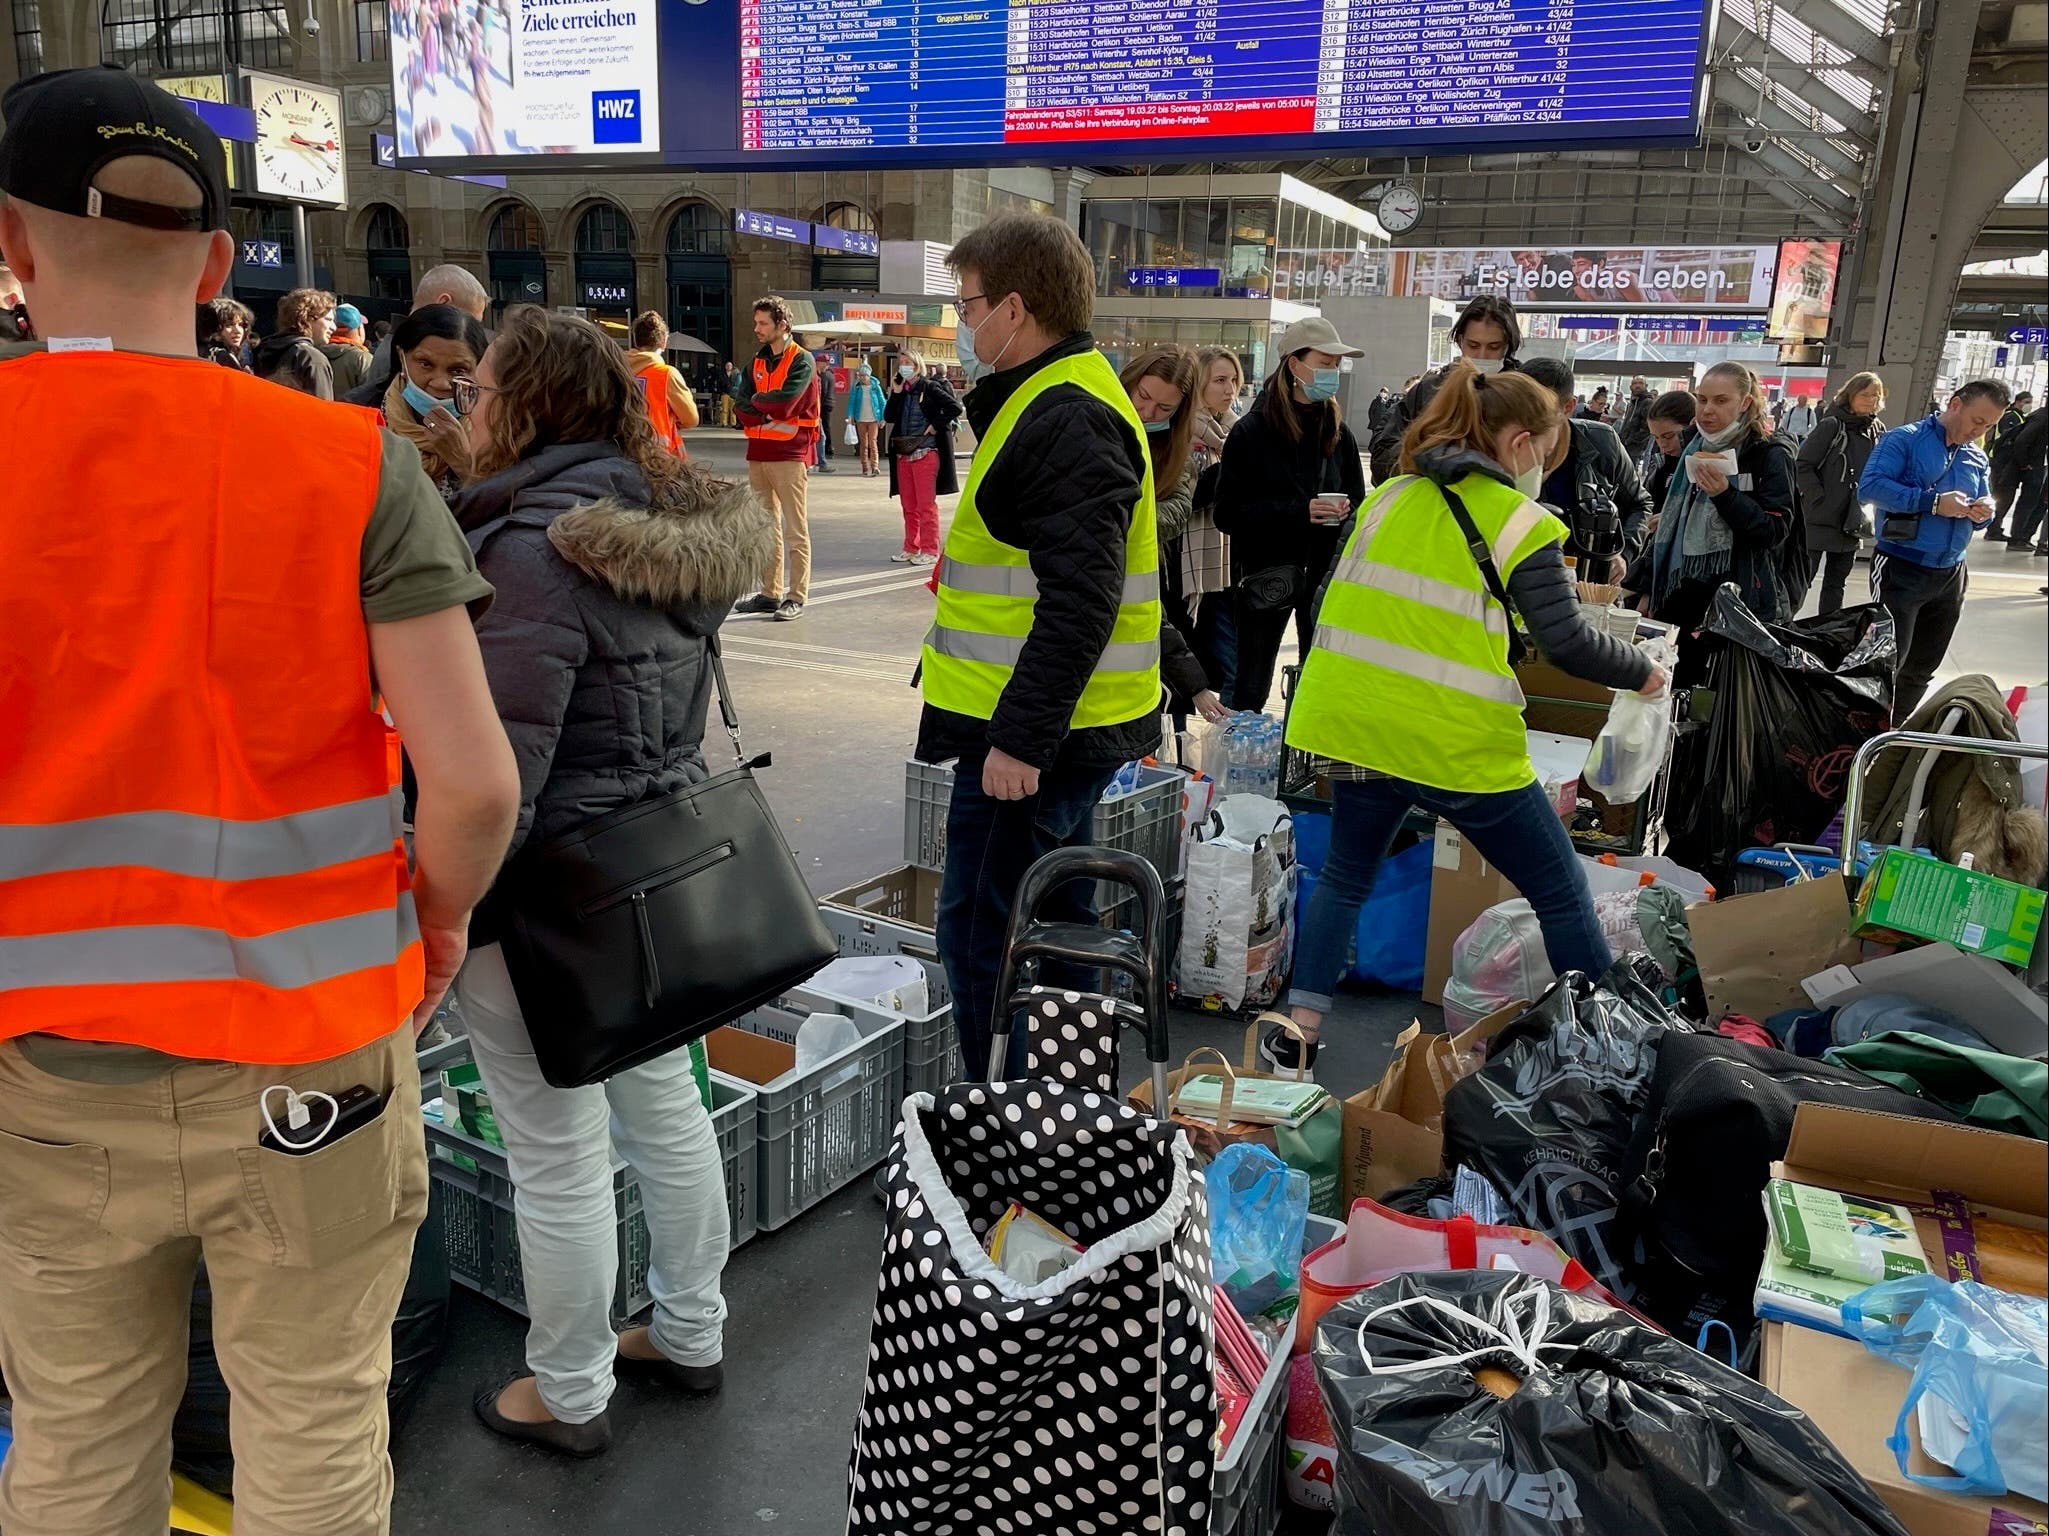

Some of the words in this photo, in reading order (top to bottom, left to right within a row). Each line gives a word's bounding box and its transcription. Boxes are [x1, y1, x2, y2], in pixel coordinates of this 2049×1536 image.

[522, 12, 559, 32] Ziele
[562, 9, 636, 29] erreichen
[1347, 33, 1368, 43] 15:46
[1370, 30, 1417, 42] Hardbrücke
[1422, 28, 1456, 39] Oerlikon
[1460, 26, 1487, 37] Zürich
[1489, 24, 1531, 37] Flughafen
[1546, 22, 1572, 32] 41/42
[1346, 45, 1368, 55] 15:46
[1369, 43, 1417, 54] Stadelhofen
[1421, 40, 1462, 52] Stettbach
[1467, 38, 1511, 49] Winterthur
[1544, 35, 1570, 45] 43/44
[1345, 58, 1367, 68] 15:47
[1368, 56, 1405, 66] Wiedikon
[1409, 54, 1431, 66] Enge
[1436, 52, 1464, 63] Thalwil
[1468, 50, 1518, 61] Unterterzen
[1319, 73, 1334, 81] S14
[1344, 70, 1366, 80] 15:49
[1366, 68, 1405, 79] Altstetten
[1409, 66, 1436, 77] Urdorf
[1440, 64, 1475, 75] Affoltern
[1492, 62, 1514, 73] Albis
[1343, 82, 1365, 92] 15:49
[1366, 80, 1413, 91] Hardbrücke
[1417, 78, 1451, 89] Oerlikon
[1455, 77, 1488, 89] Opfikon
[1493, 74, 1538, 85] Winterthur
[1540, 73, 1566, 83] 41/42
[1342, 95, 1362, 105] 15:51
[1365, 93, 1402, 104] Wiedikon
[1406, 92, 1427, 104] Enge
[1432, 90, 1479, 101] Wollishofen
[1483, 89, 1500, 100] Zug
[598, 98, 635, 119] HWZ
[1341, 107, 1362, 116] 15:52
[1364, 104, 1410, 116] Hardbrücke
[1414, 103, 1449, 114] Oerlikon
[1453, 100, 1521, 114] Niederweningen
[1538, 99, 1563, 109] 41/42
[1316, 121, 1326, 129] S5
[1340, 119, 1361, 129] 15:54
[1363, 117, 1410, 128] Stadelhofen
[1415, 116, 1437, 126] Uster
[1441, 114, 1479, 125] Wetzikon
[1483, 112, 1520, 123] Pfäffikon
[1536, 111, 1561, 121] 43/44
[1145, 276, 1154, 284] 21
[1167, 276, 1178, 284] 34
[1478, 265, 1509, 289] Es
[1517, 264, 1574, 289] lebe
[1581, 264, 1631, 289] das
[1638, 264, 1734, 289] Leben.
[588, 287, 626, 298] OSCAR
[872, 310, 905, 320] EXPRESS
[2030, 334, 2041, 342] 21
[1755, 857, 1792, 868] MAXIMUS
[1522, 1147, 1619, 1184] KEHRICHTSAC
[1687, 1310, 1711, 1322] MIGR
